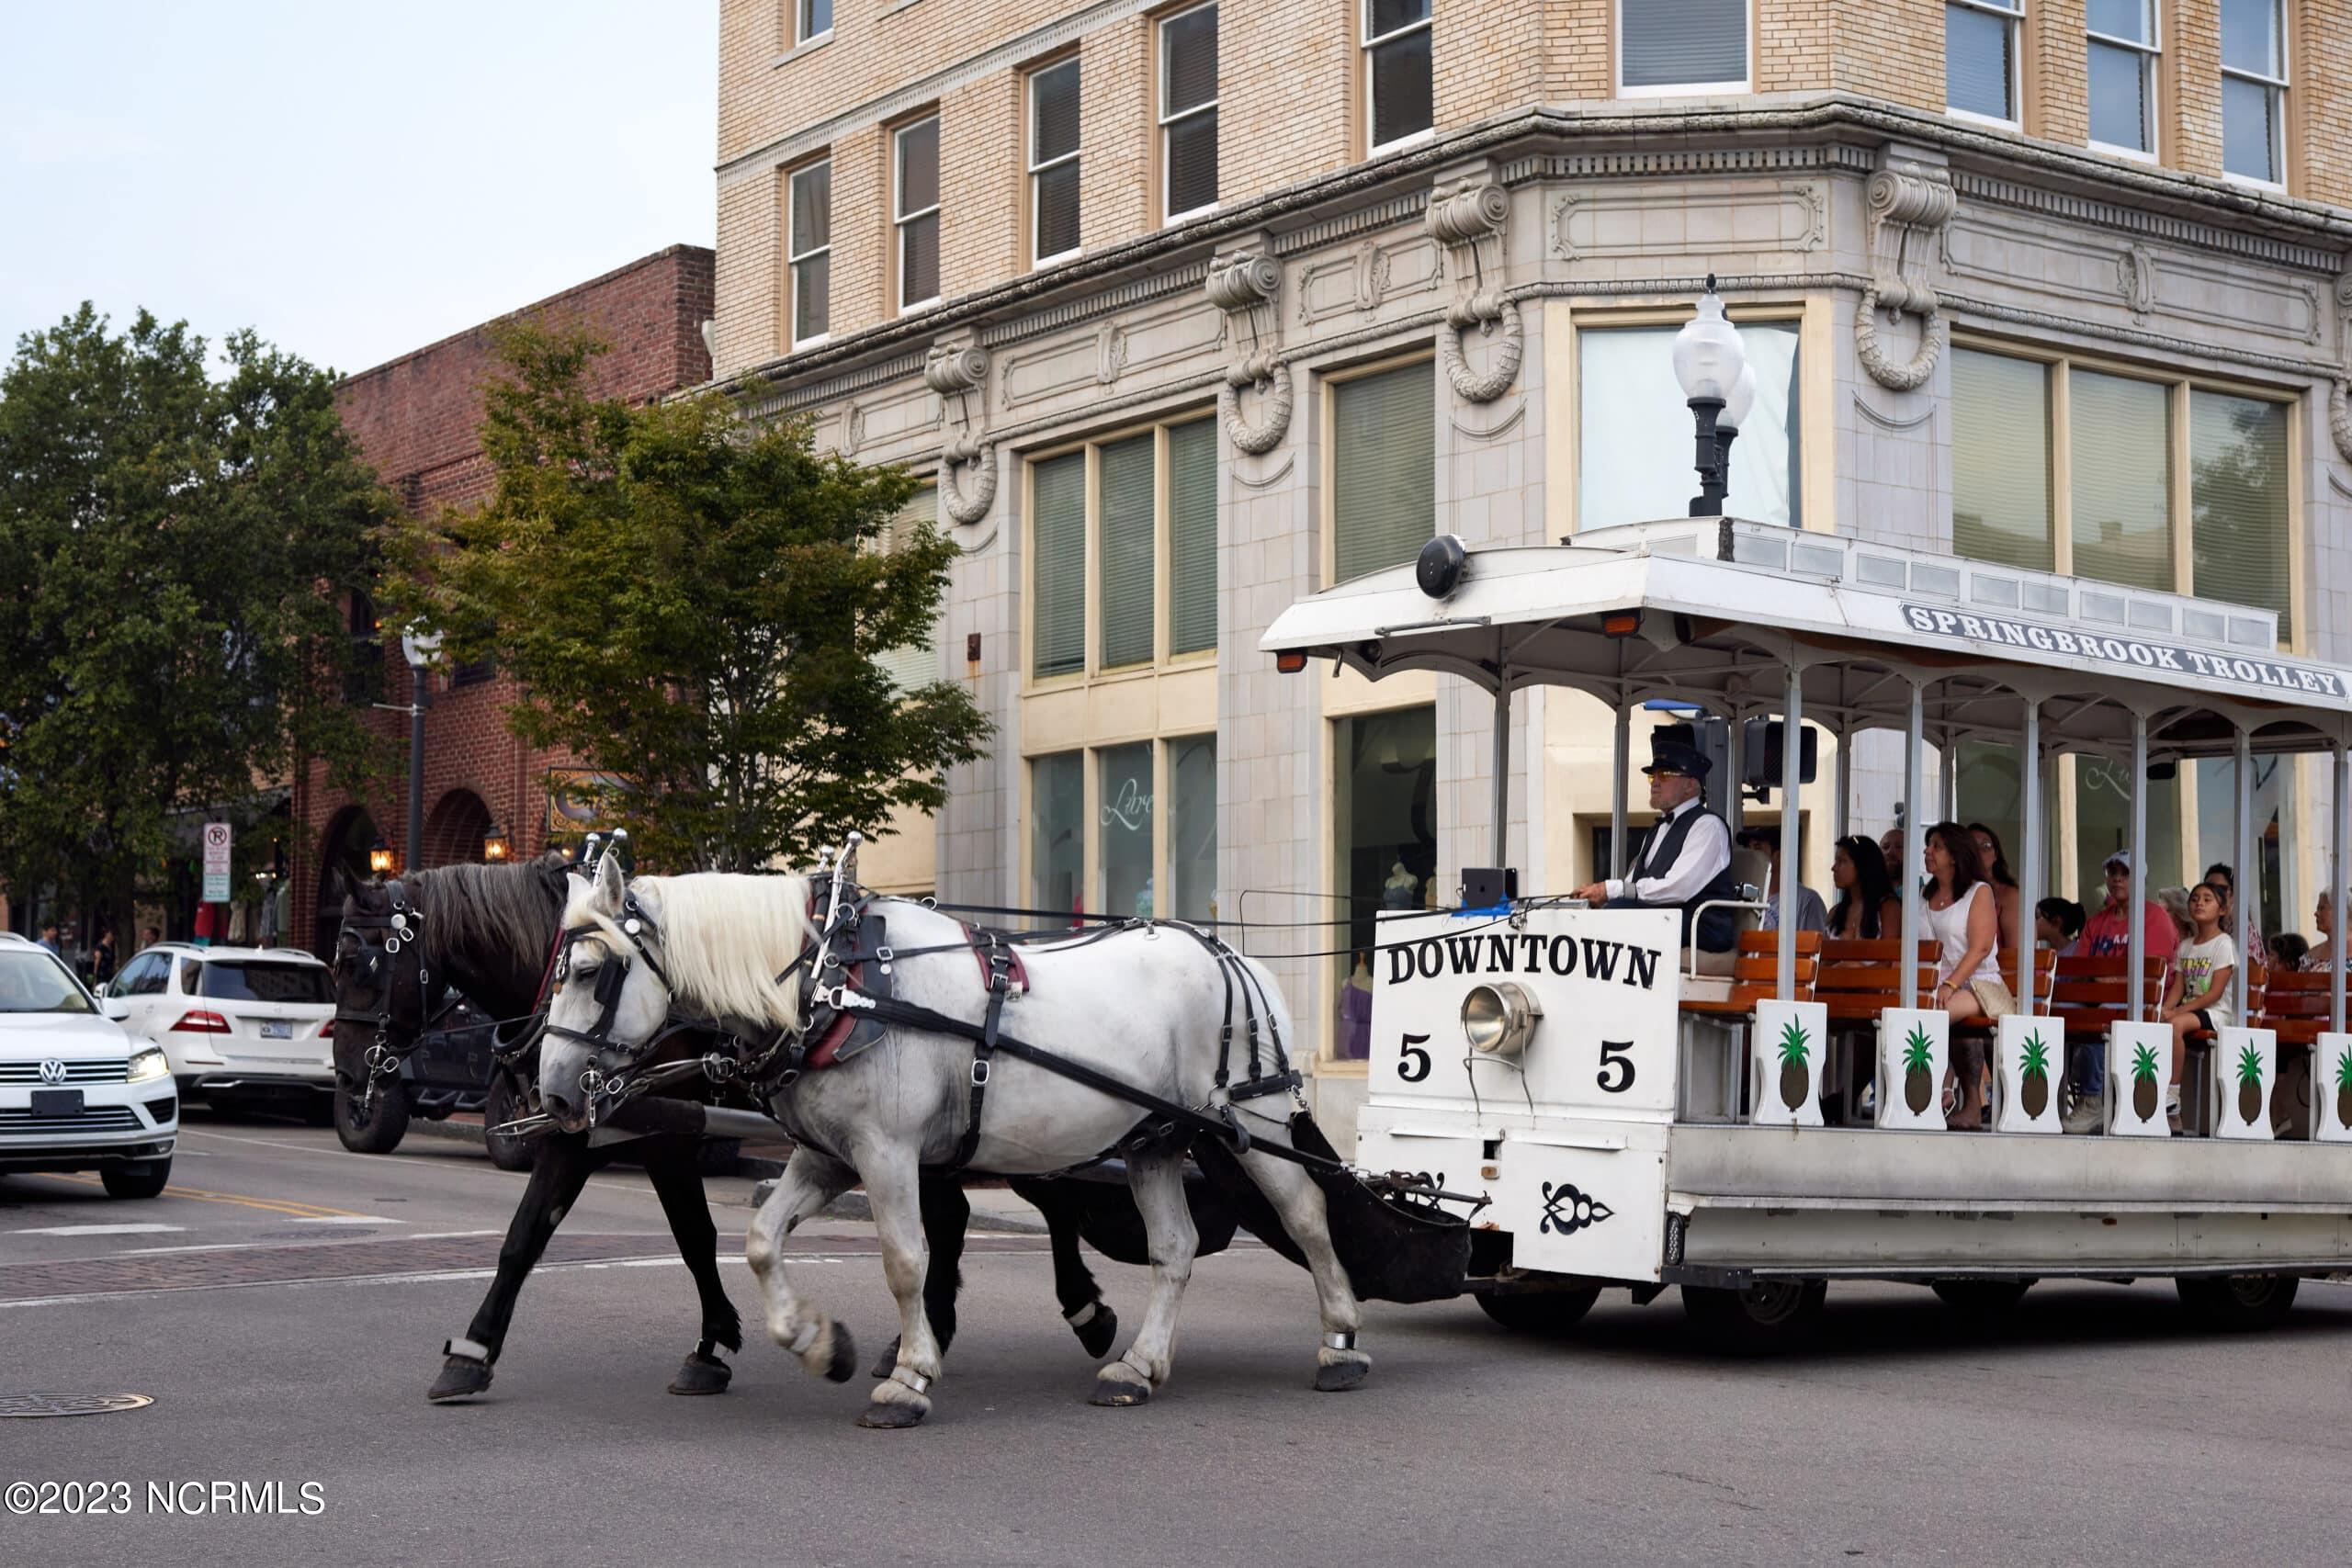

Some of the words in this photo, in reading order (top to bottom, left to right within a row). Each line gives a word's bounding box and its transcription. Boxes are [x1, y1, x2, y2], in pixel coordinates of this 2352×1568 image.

[1910, 606, 2183, 672] SPRINGBROOK
[2187, 651, 2337, 696] TROLLEY
[1387, 933, 1662, 989] DOWNTOWN
[1396, 1032, 1431, 1082] 5
[1596, 1040, 1635, 1093] 5
